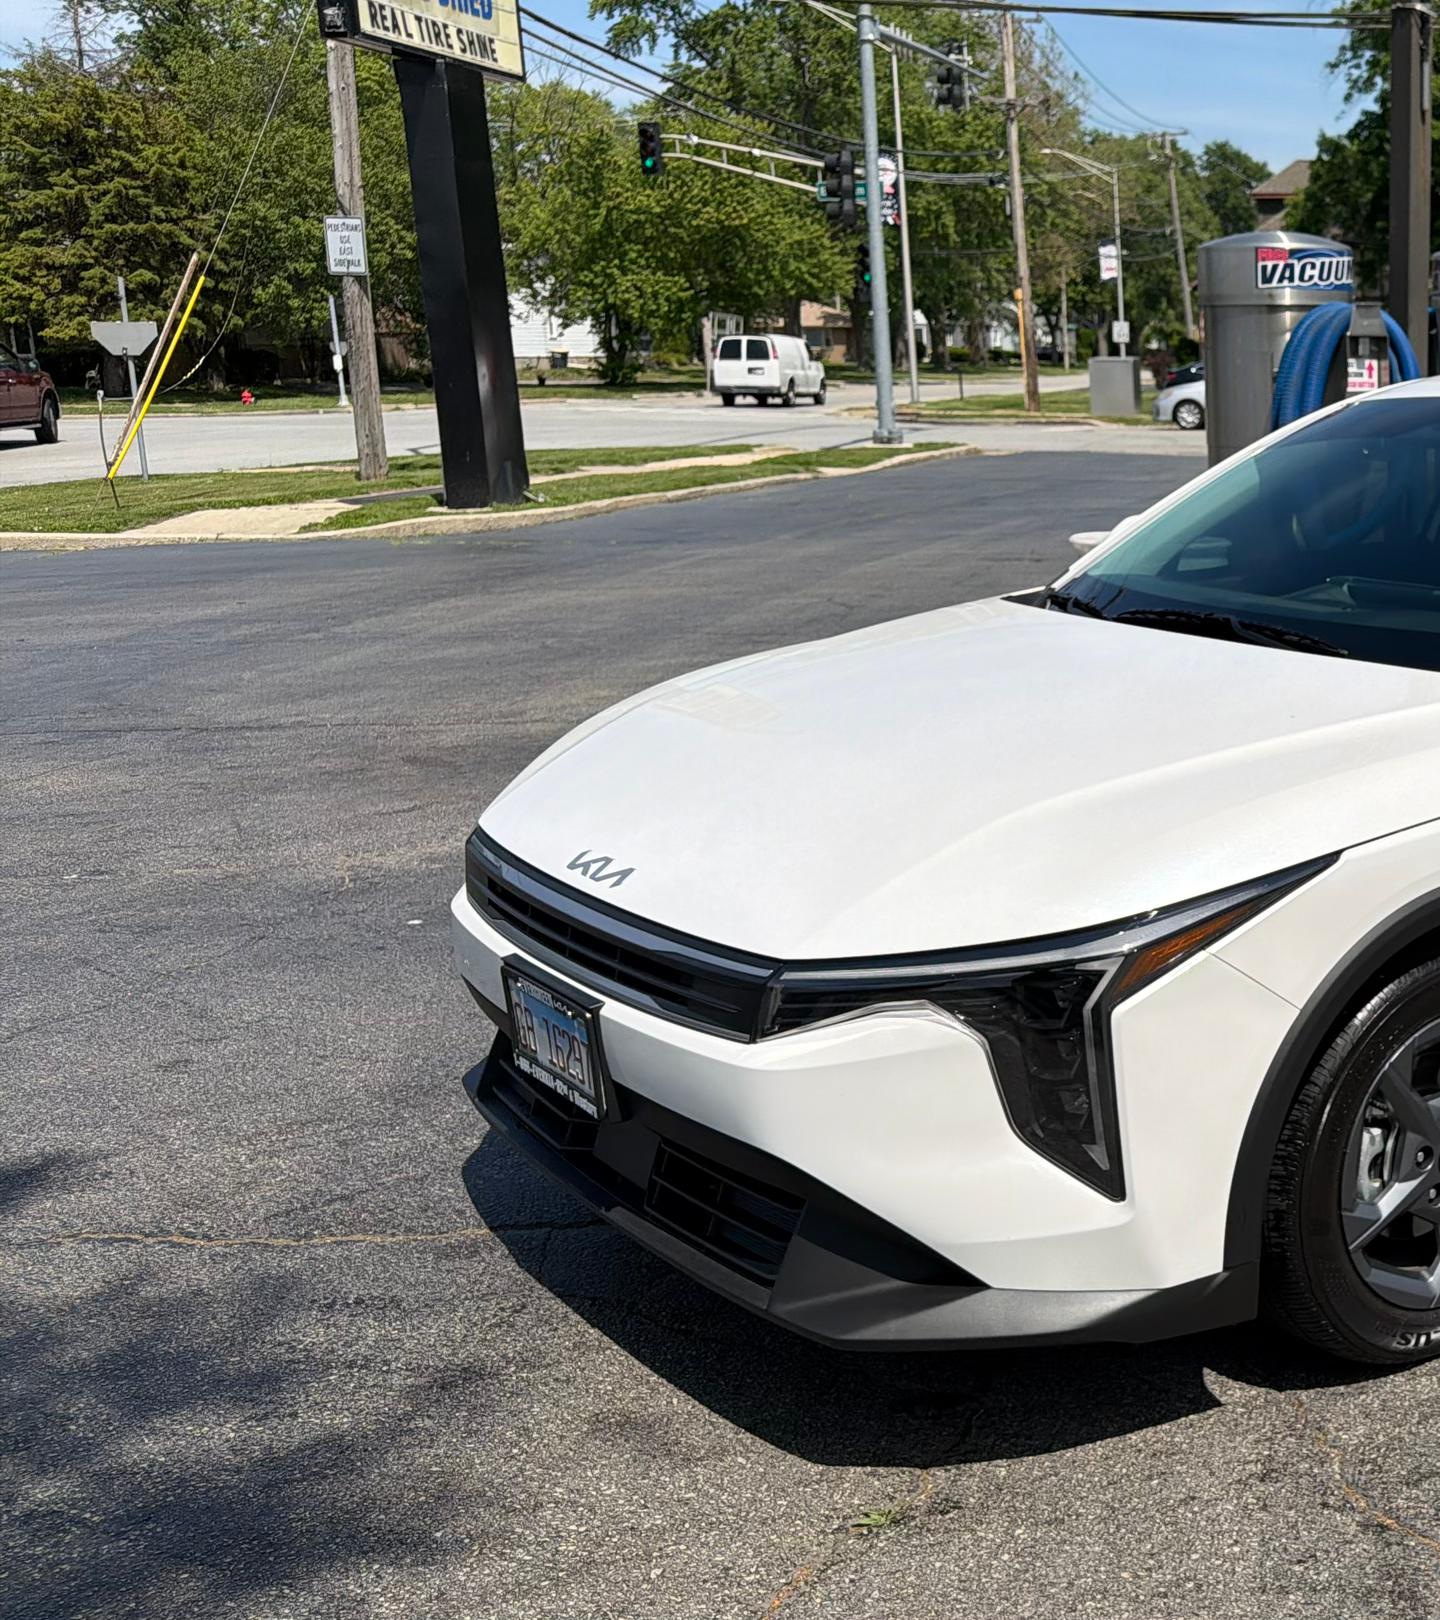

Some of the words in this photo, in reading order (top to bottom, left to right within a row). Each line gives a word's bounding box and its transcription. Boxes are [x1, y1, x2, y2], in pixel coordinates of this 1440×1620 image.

[368, 1, 414, 39] REAL
[415, 15, 454, 50] TIRE
[438, 0, 493, 20] RIED
[566, 850, 637, 888] KIA
